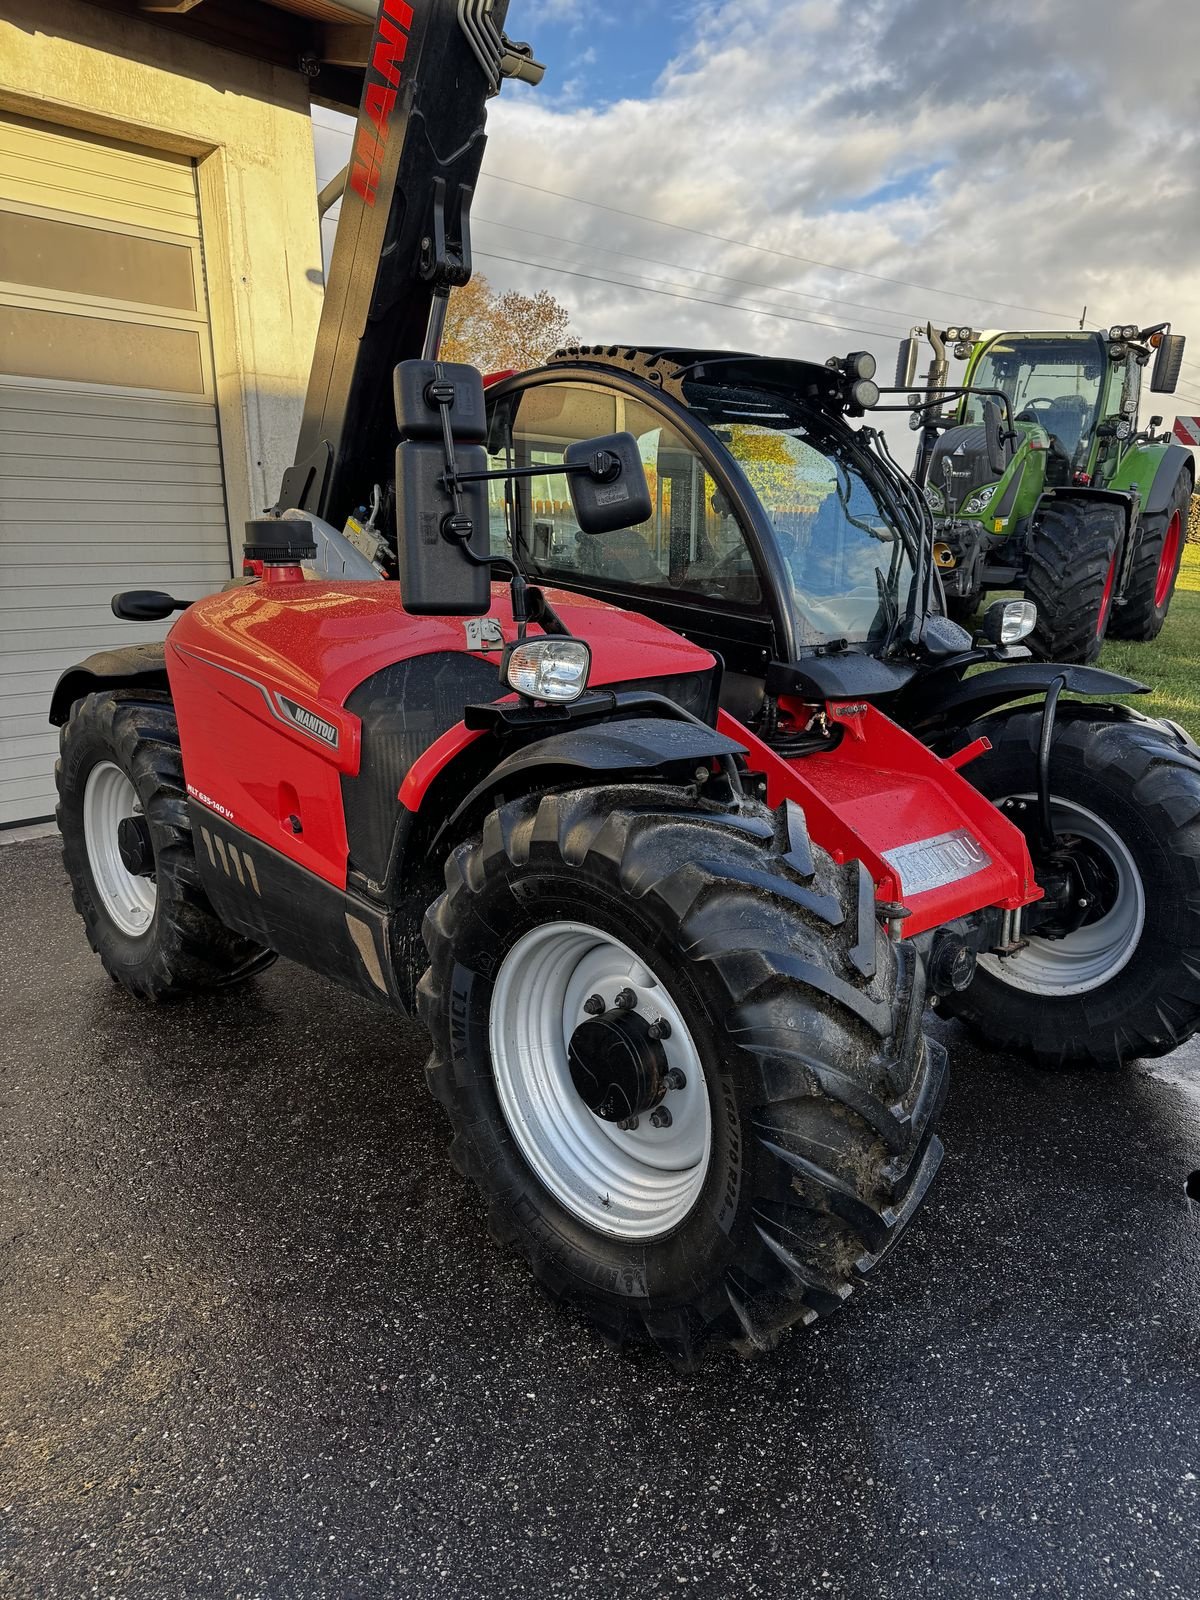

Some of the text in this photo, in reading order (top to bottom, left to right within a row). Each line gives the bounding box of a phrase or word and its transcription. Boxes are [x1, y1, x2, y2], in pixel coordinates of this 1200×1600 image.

[295, 707, 336, 741] MANITOU
[187, 783, 199, 797] MLT
[198, 791, 225, 814] 635-140
[895, 836, 984, 888] ANITOU
[451, 990, 468, 1062] XMCL
